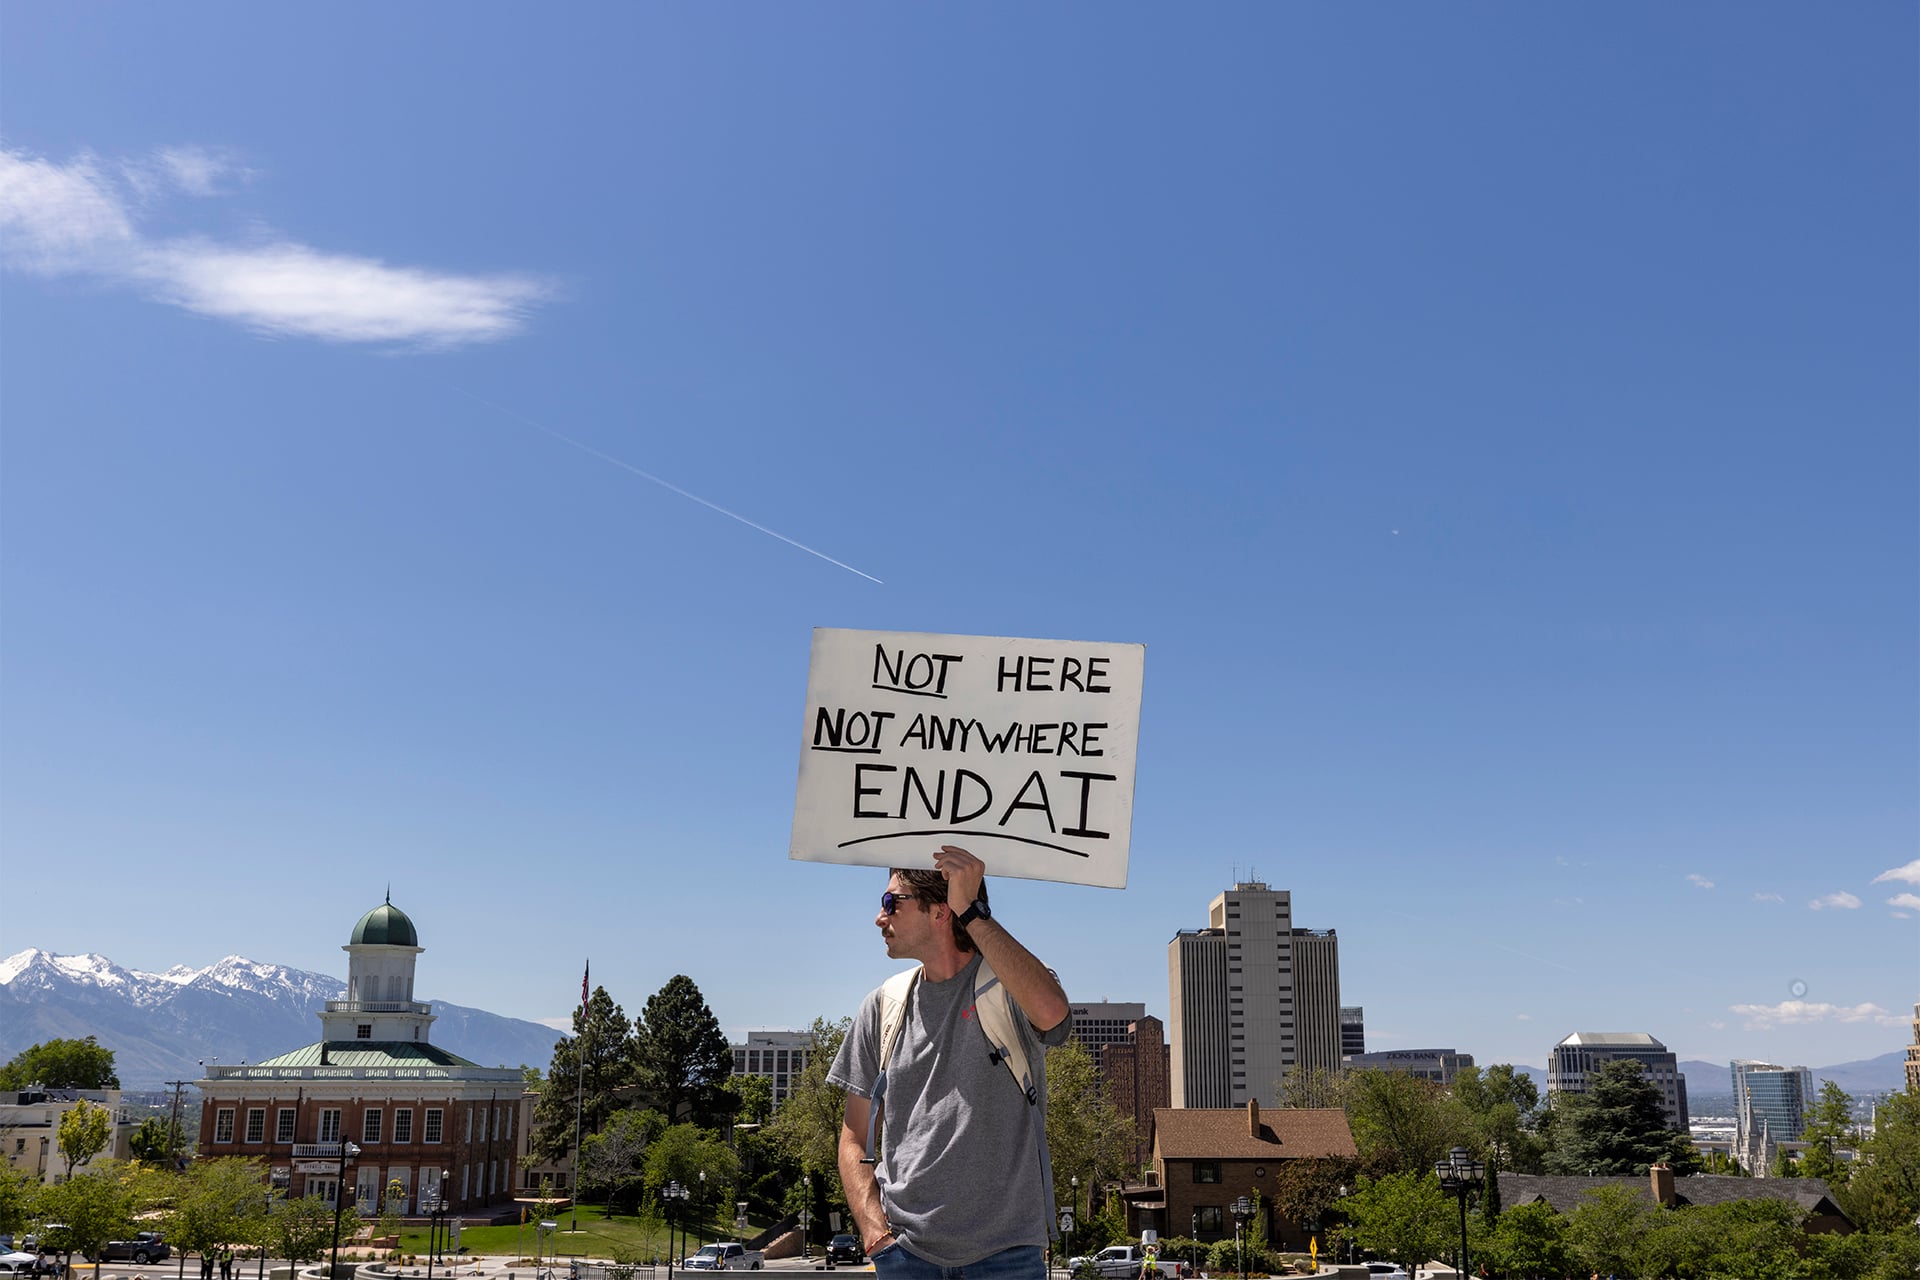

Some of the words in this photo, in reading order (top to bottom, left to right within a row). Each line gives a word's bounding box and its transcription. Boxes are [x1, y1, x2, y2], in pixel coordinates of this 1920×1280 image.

[873, 643, 963, 694] NOT
[997, 656, 1112, 693] HERE
[813, 706, 896, 749] NOT
[900, 712, 1109, 757] ANYWHERE
[1072, 1007, 1089, 1016] ank
[1386, 1052, 1411, 1060] ZIONS
[1414, 1052, 1438, 1060] BANK
